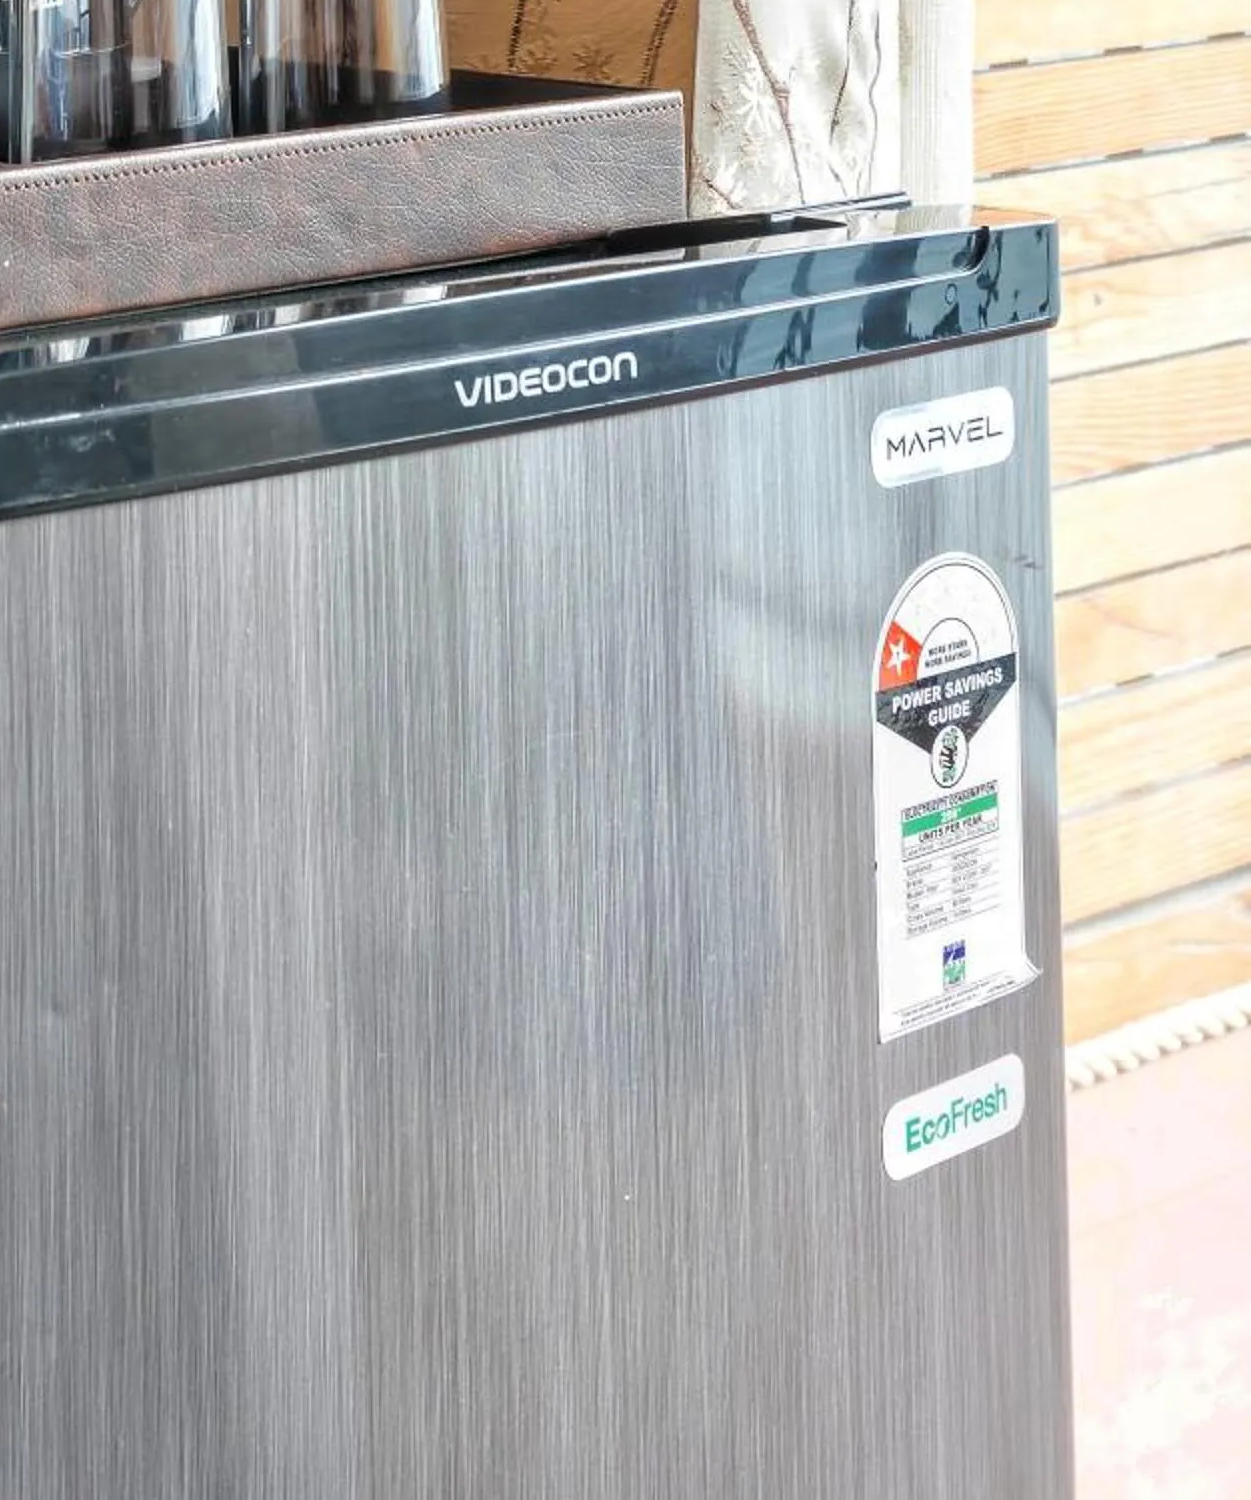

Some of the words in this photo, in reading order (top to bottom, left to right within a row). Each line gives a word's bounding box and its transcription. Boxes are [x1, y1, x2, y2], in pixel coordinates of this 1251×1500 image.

[455, 350, 638, 408] VIDEOCON
[886, 414, 1005, 462] MARVEL
[892, 685, 942, 715] POWER
[944, 667, 1003, 699] SAVINGS
[928, 699, 971, 727] GUIDE
[945, 821, 960, 833] PER
[905, 1082, 1009, 1153] EcoFresh
